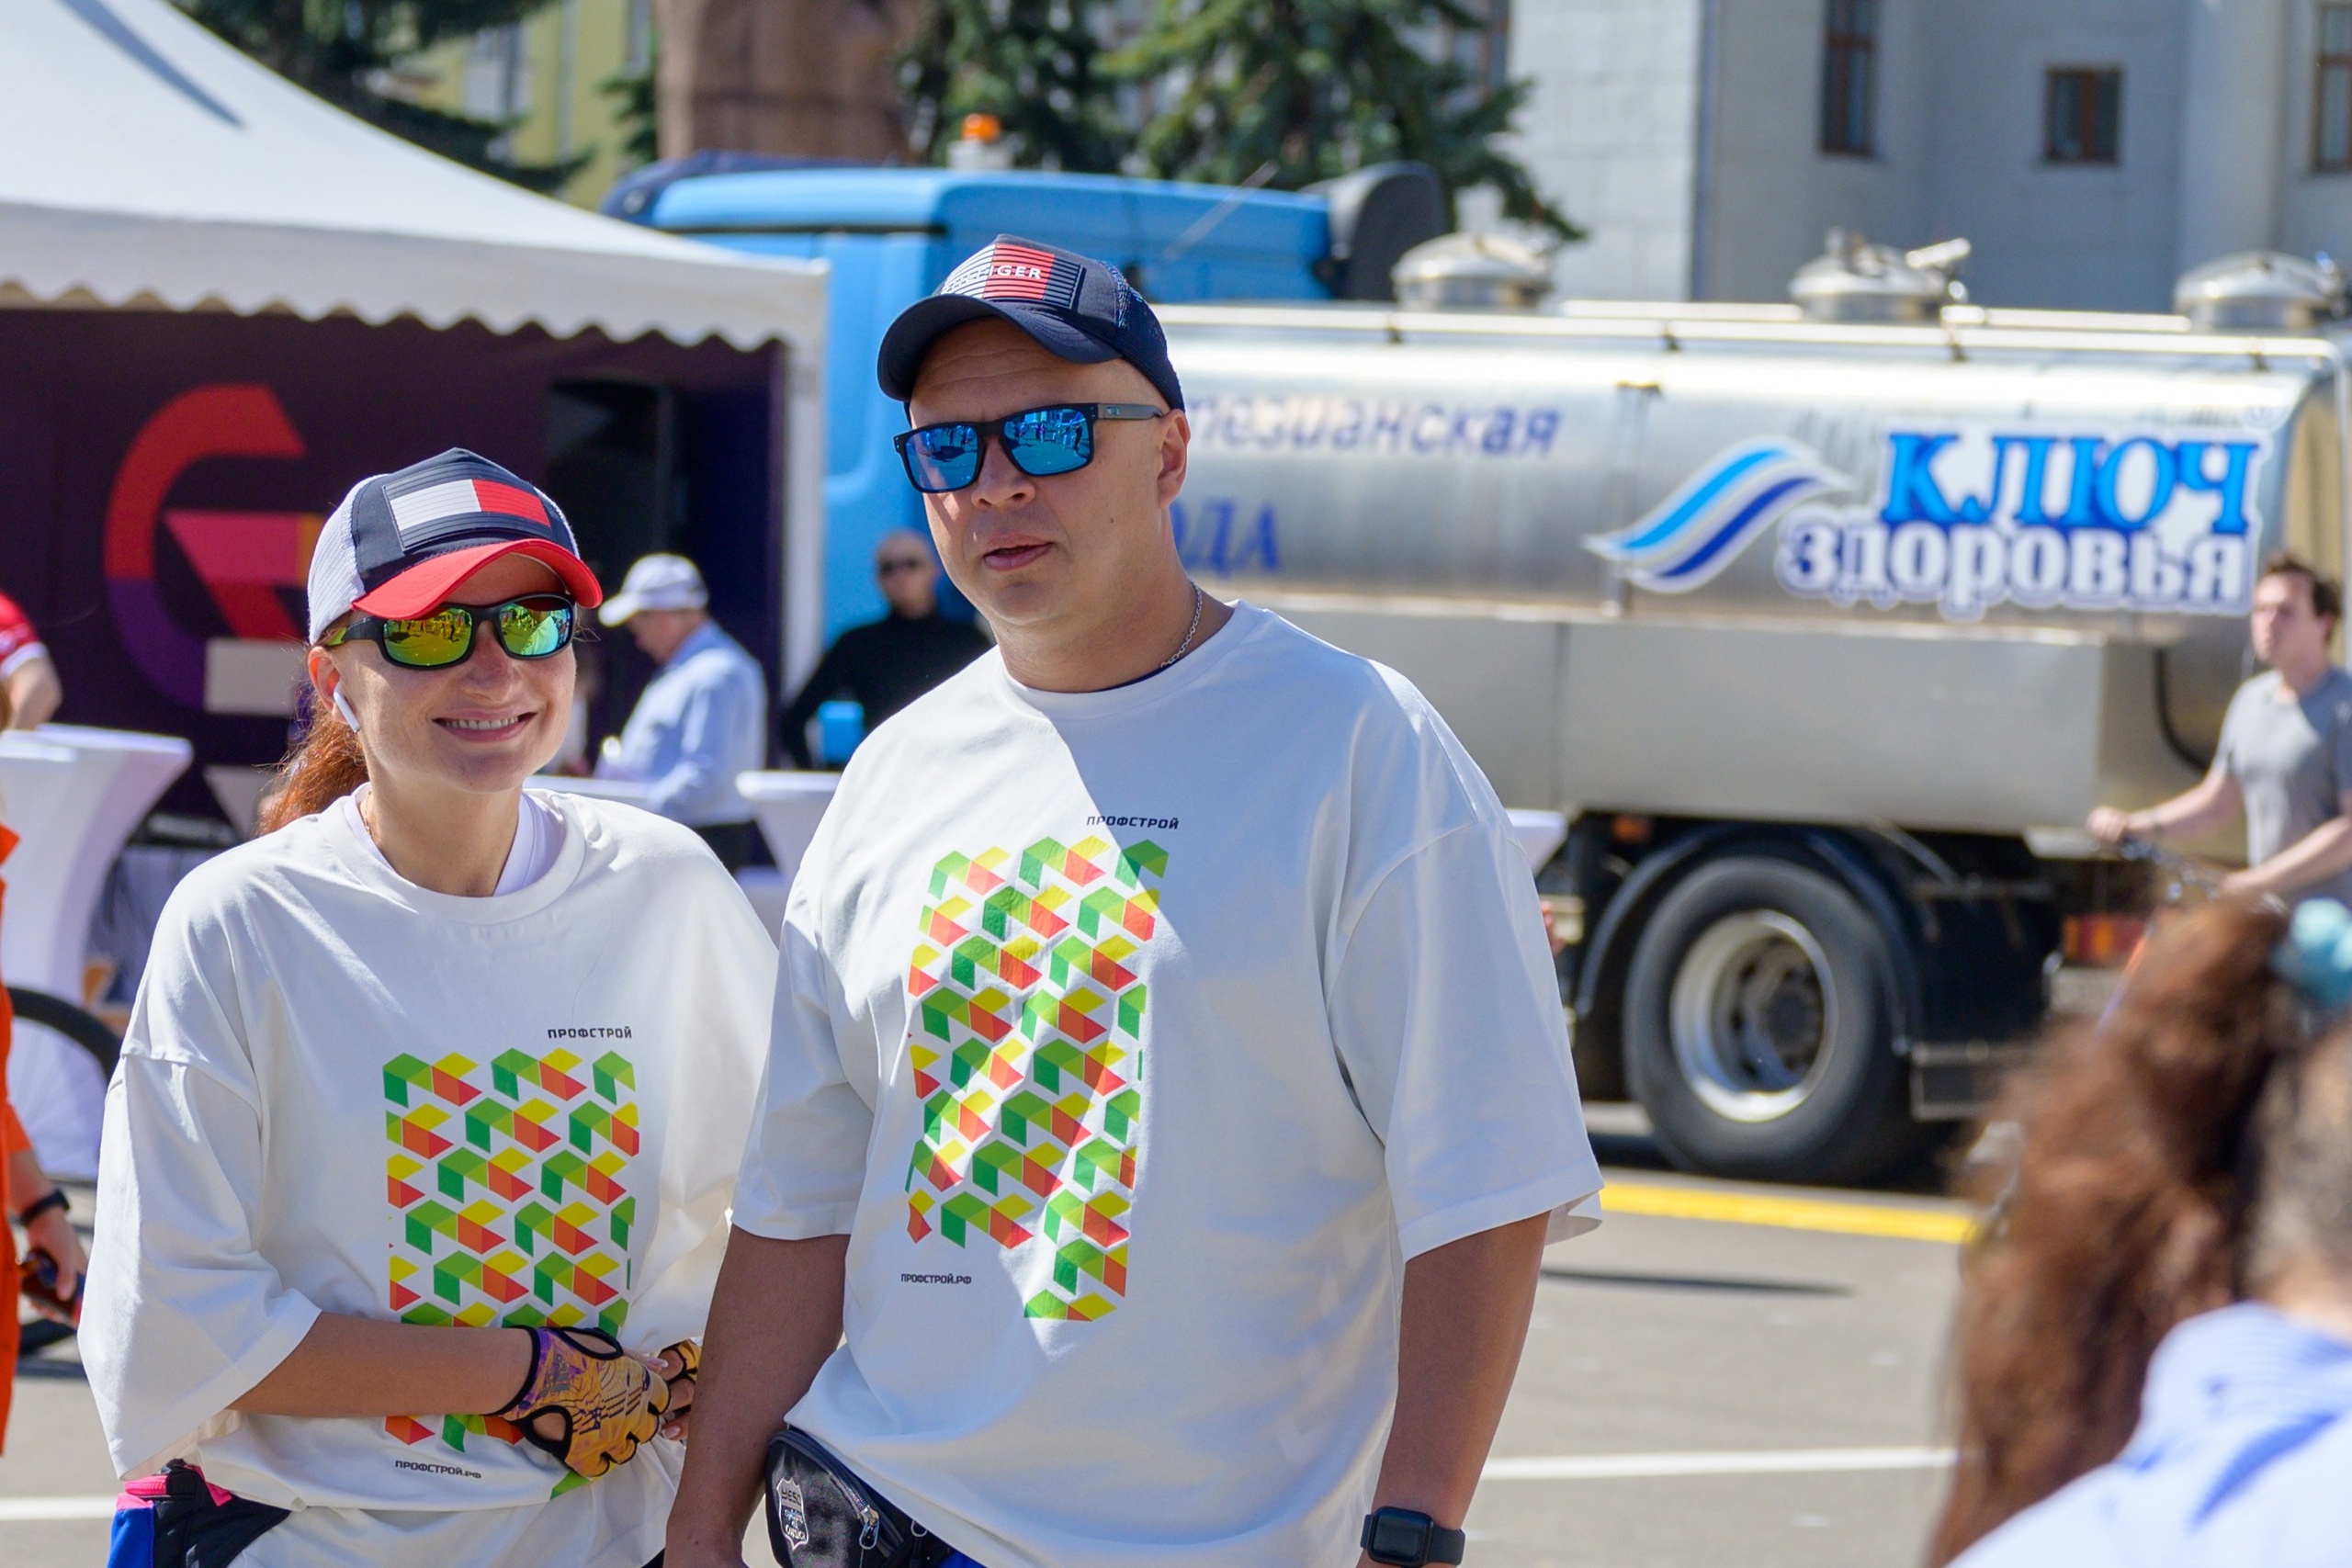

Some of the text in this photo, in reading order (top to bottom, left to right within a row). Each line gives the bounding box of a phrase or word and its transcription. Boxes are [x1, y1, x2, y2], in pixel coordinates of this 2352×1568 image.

[1881, 434, 2259, 535] КЛЮЧ
[1785, 516, 2248, 612] здоровья
[1086, 816, 1180, 829] ПРОФСТРОЙ
[548, 1026, 632, 1039] ПРОФСТРОЙ
[900, 1273, 972, 1285] ПРОФСТРОЙ.РФ
[395, 1460, 481, 1479] ПРОФСТРОЙ.РФ
